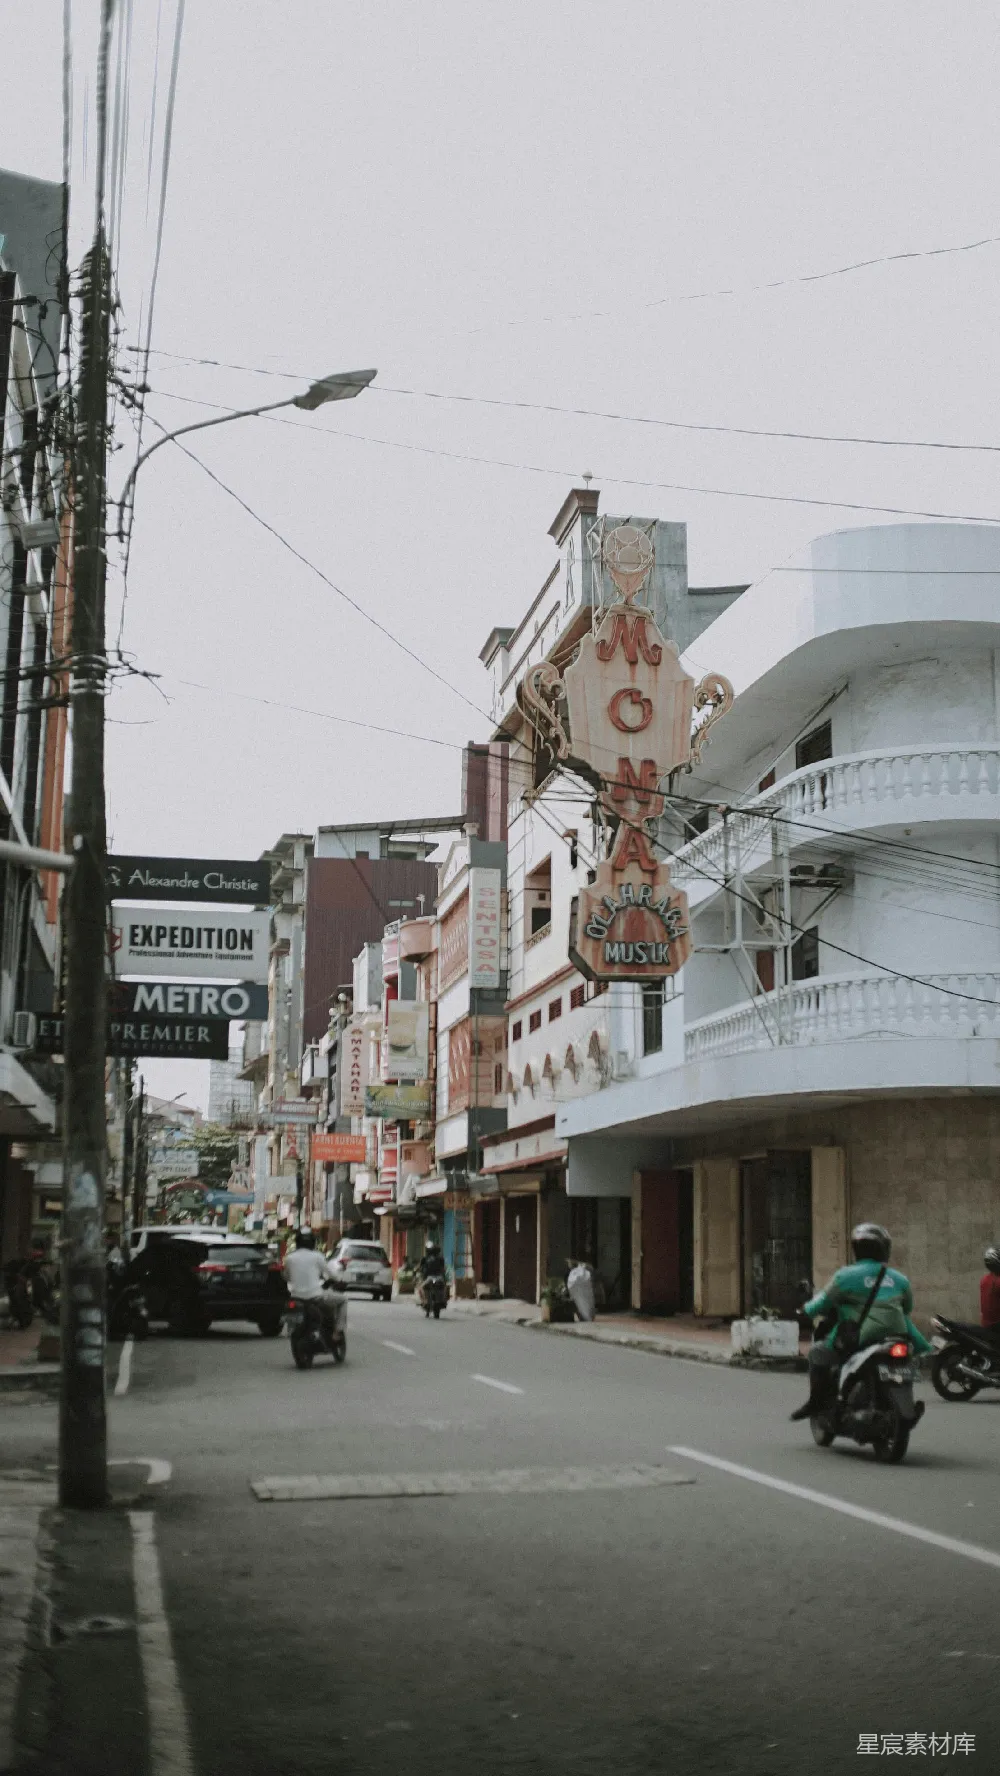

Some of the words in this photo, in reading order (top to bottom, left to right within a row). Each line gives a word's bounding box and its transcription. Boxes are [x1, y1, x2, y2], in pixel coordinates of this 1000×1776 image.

[128, 869, 199, 889] Alexandre
[203, 872, 259, 891] Christie
[585, 883, 689, 940] OLAHRAGA
[129, 924, 254, 950] EXPEDITION
[475, 887, 497, 973] SENTOSA
[604, 941, 670, 966] MUSIK
[133, 984, 249, 1015] METRO
[110, 1022, 211, 1042] PREMIER
[351, 1038, 362, 1101] MATAHARI
